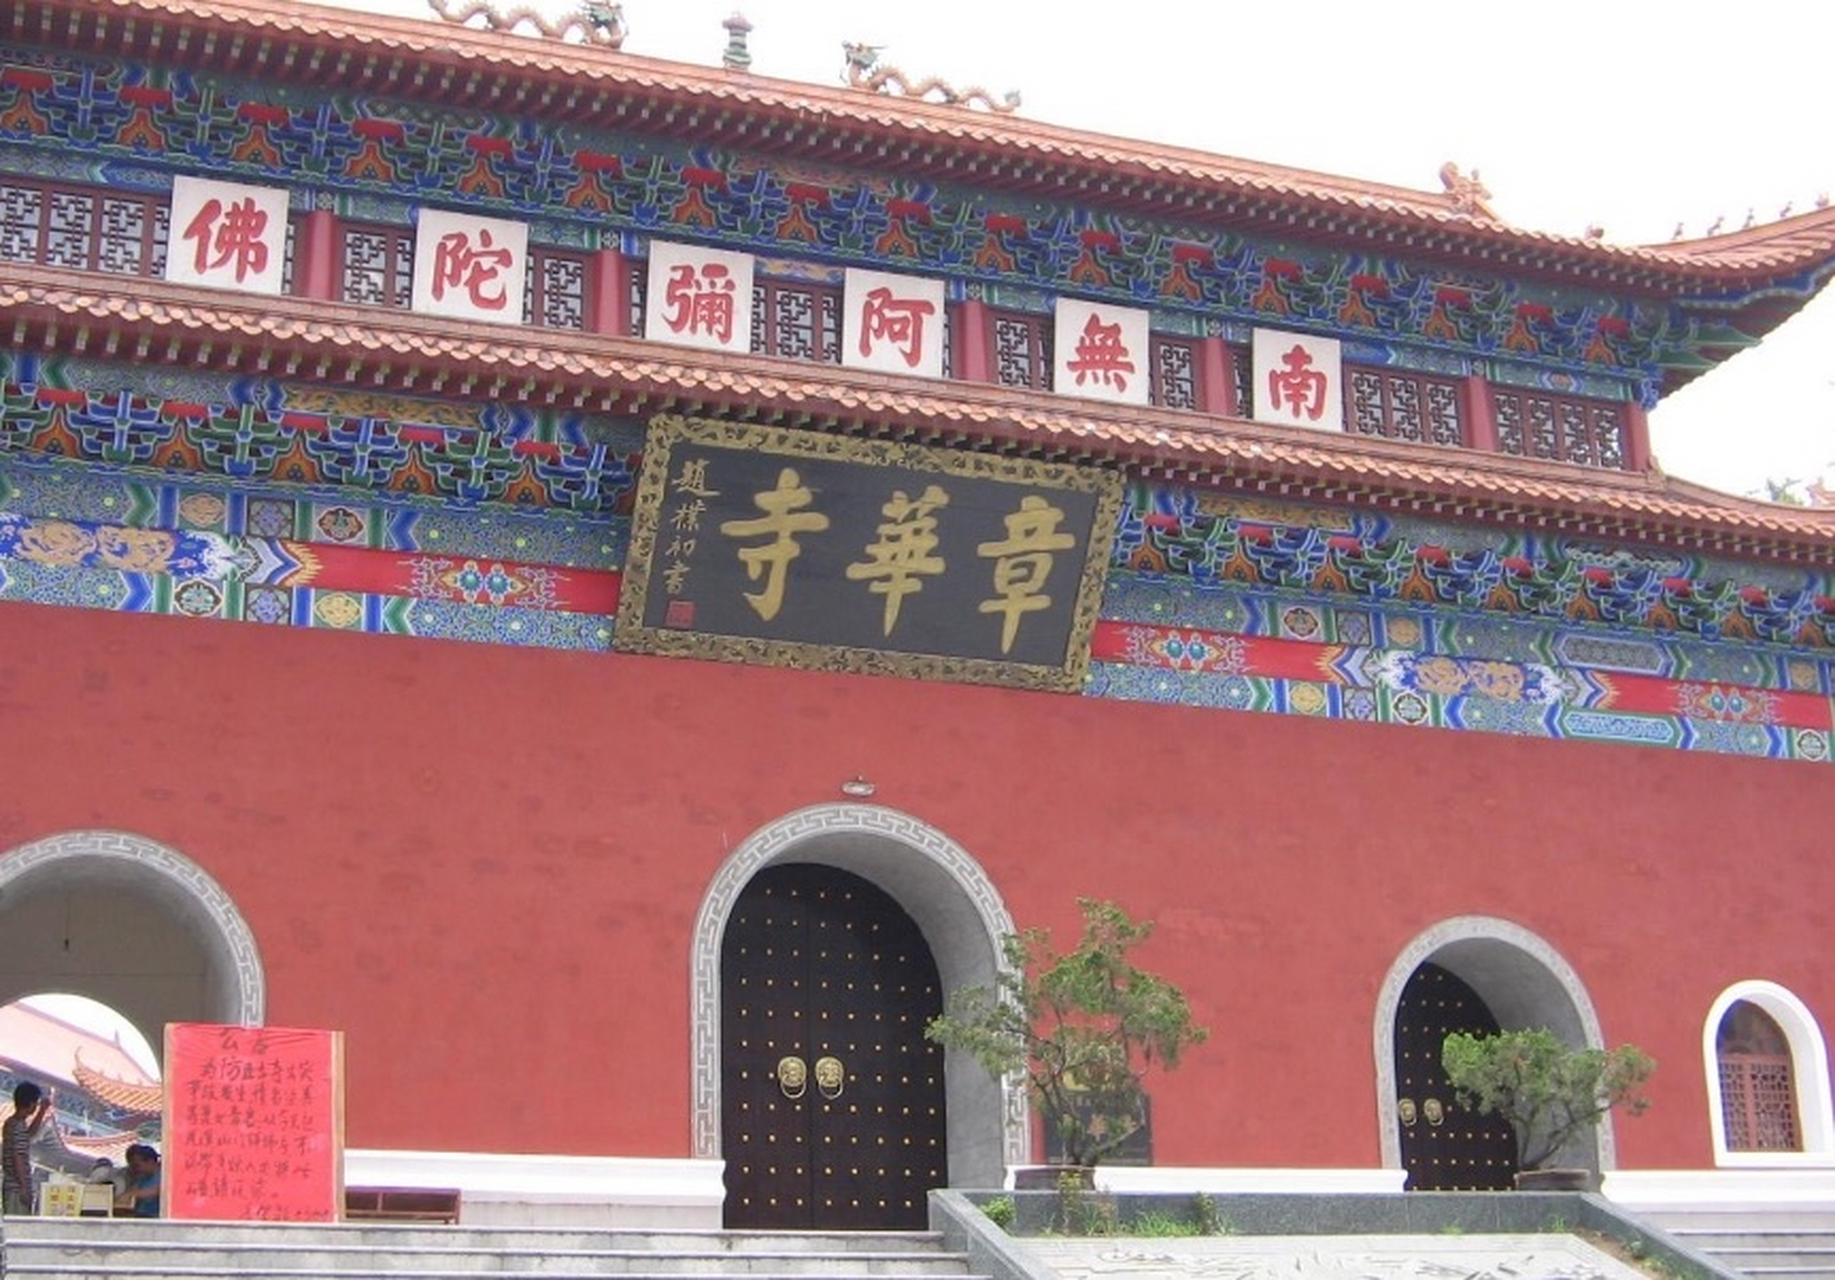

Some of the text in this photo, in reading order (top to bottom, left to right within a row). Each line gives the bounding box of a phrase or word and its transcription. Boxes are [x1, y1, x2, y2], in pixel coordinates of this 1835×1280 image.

[182, 195, 269, 283] 佛
[431, 229, 512, 310] 陀
[858, 286, 935, 367] 阿
[1066, 313, 1136, 393] 無
[1268, 344, 1328, 421] 南
